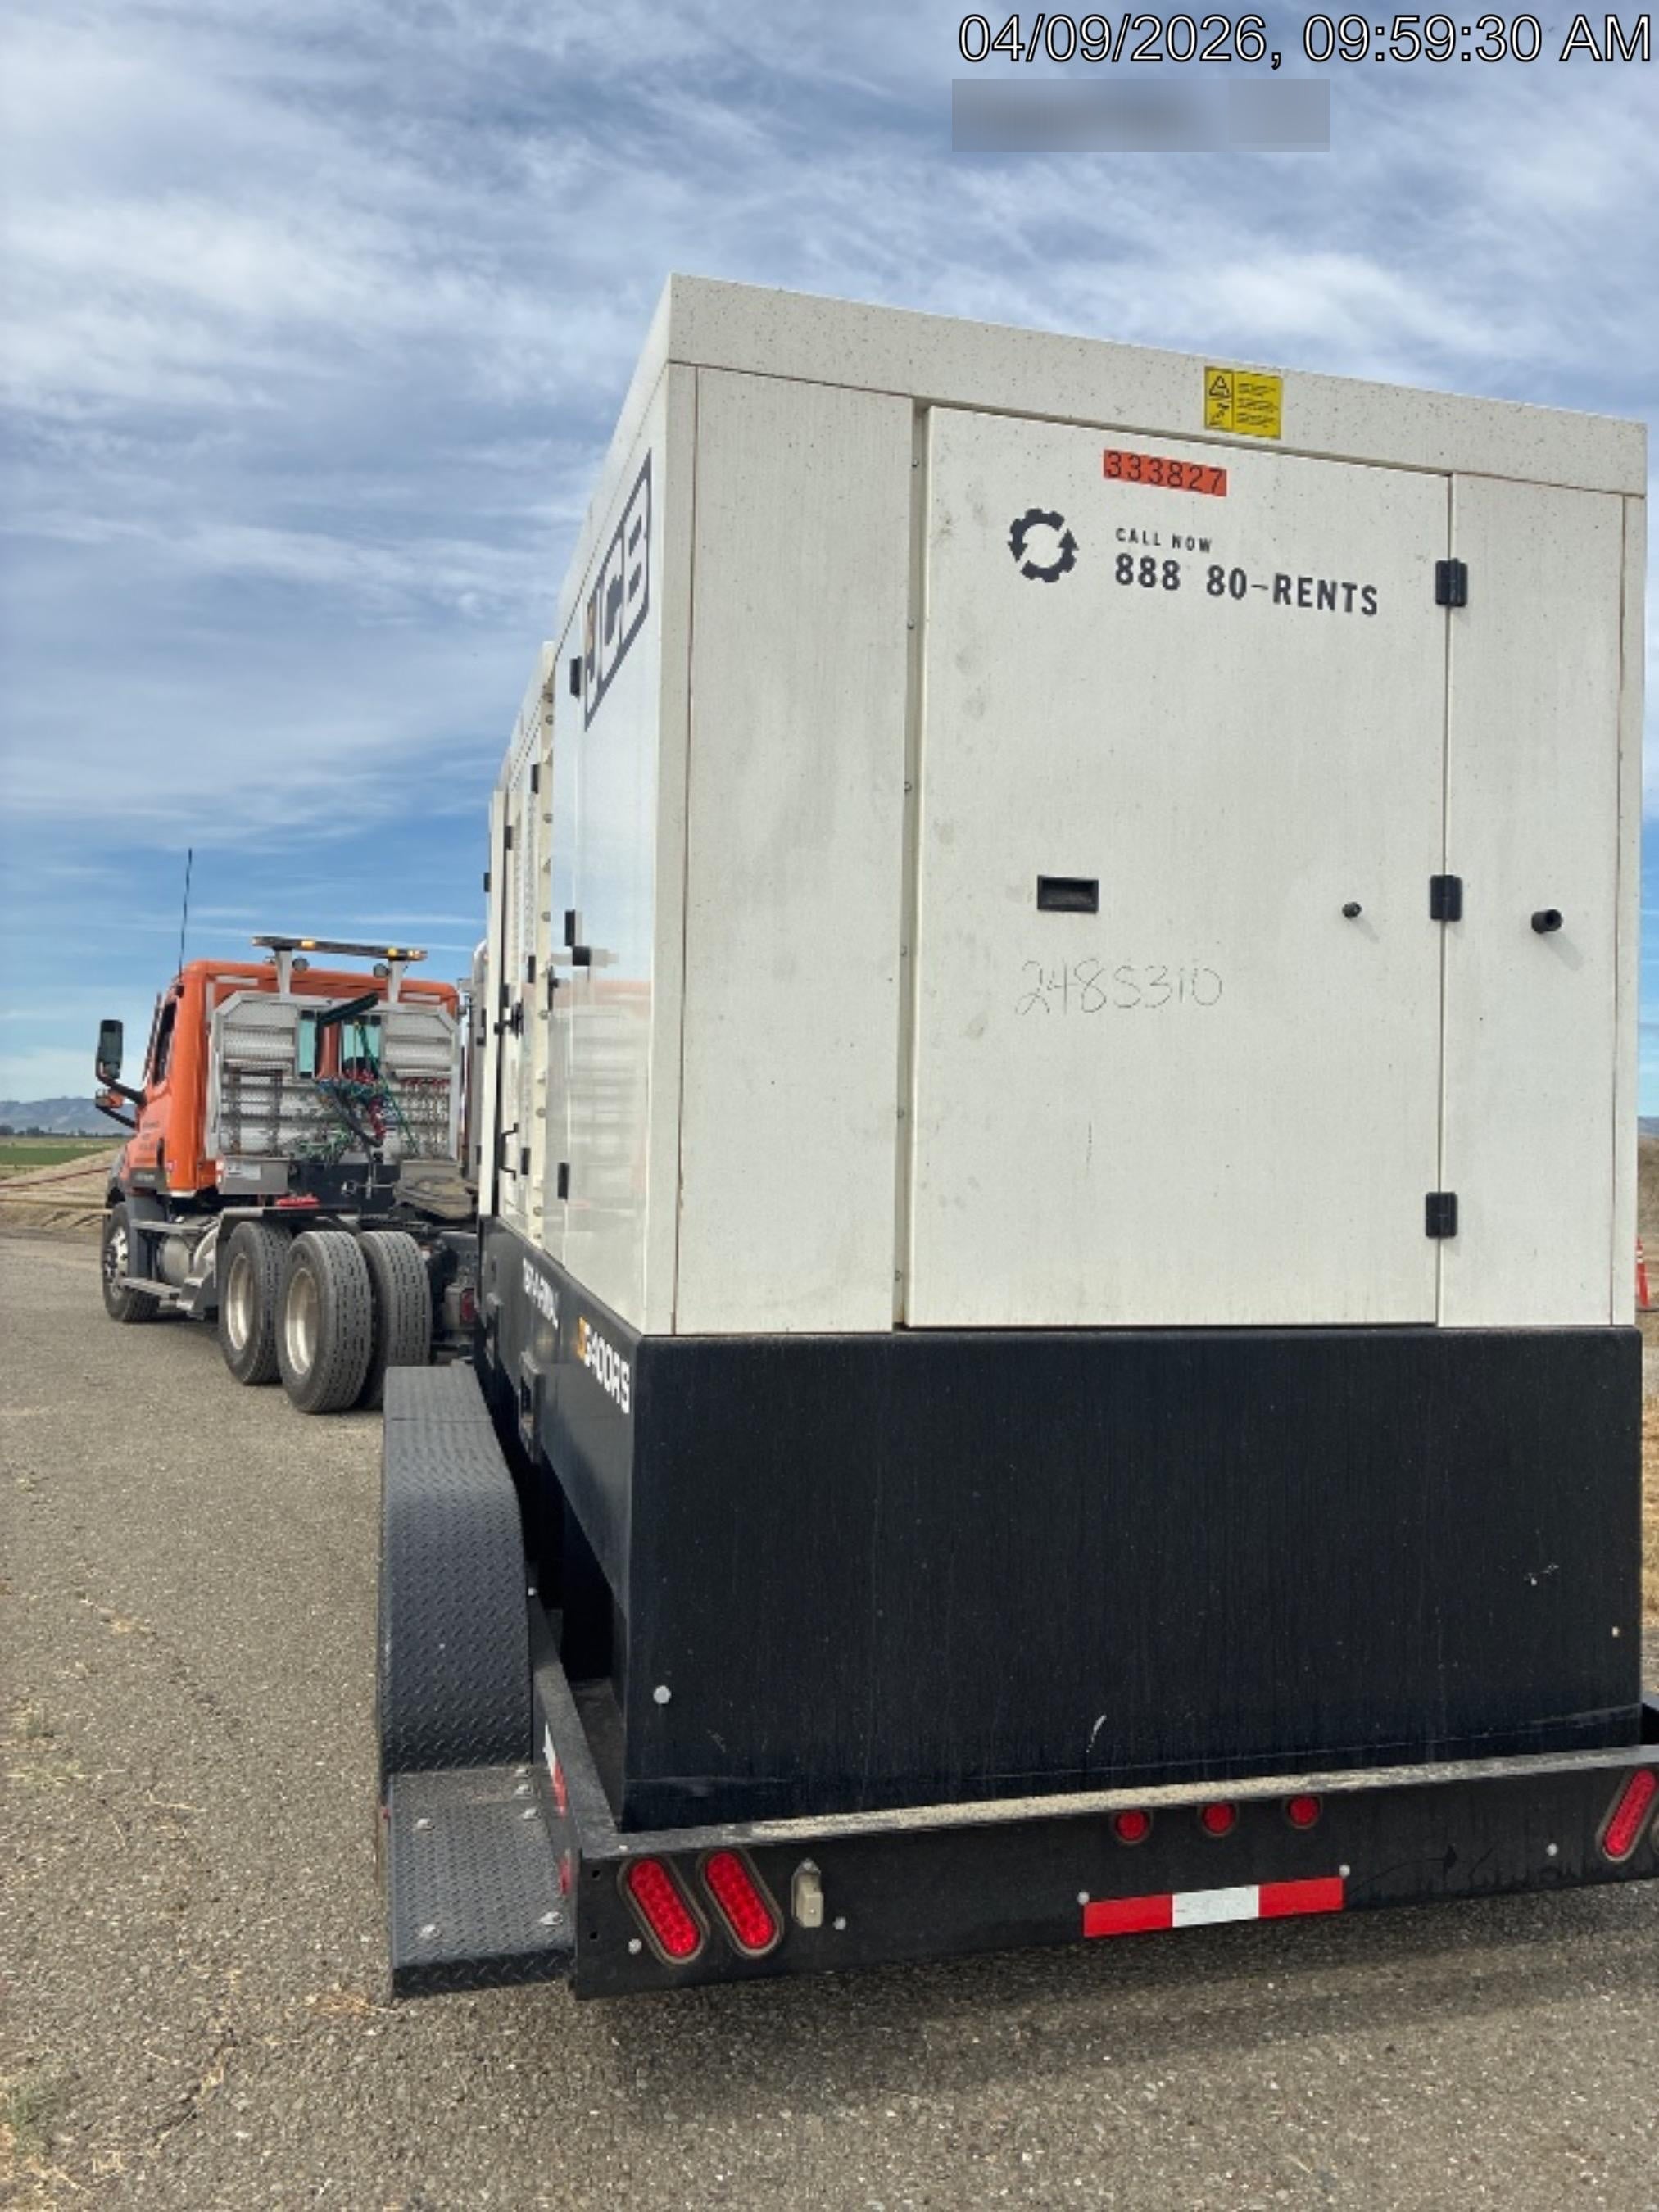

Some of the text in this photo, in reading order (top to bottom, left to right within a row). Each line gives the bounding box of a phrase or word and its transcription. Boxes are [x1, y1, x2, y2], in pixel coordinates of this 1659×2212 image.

[1107, 451, 1223, 495] 333827
[1115, 527, 1213, 554] CALL NOW
[585, 467, 650, 723] JCB
[1115, 552, 1378, 617] 888 80-RENTS
